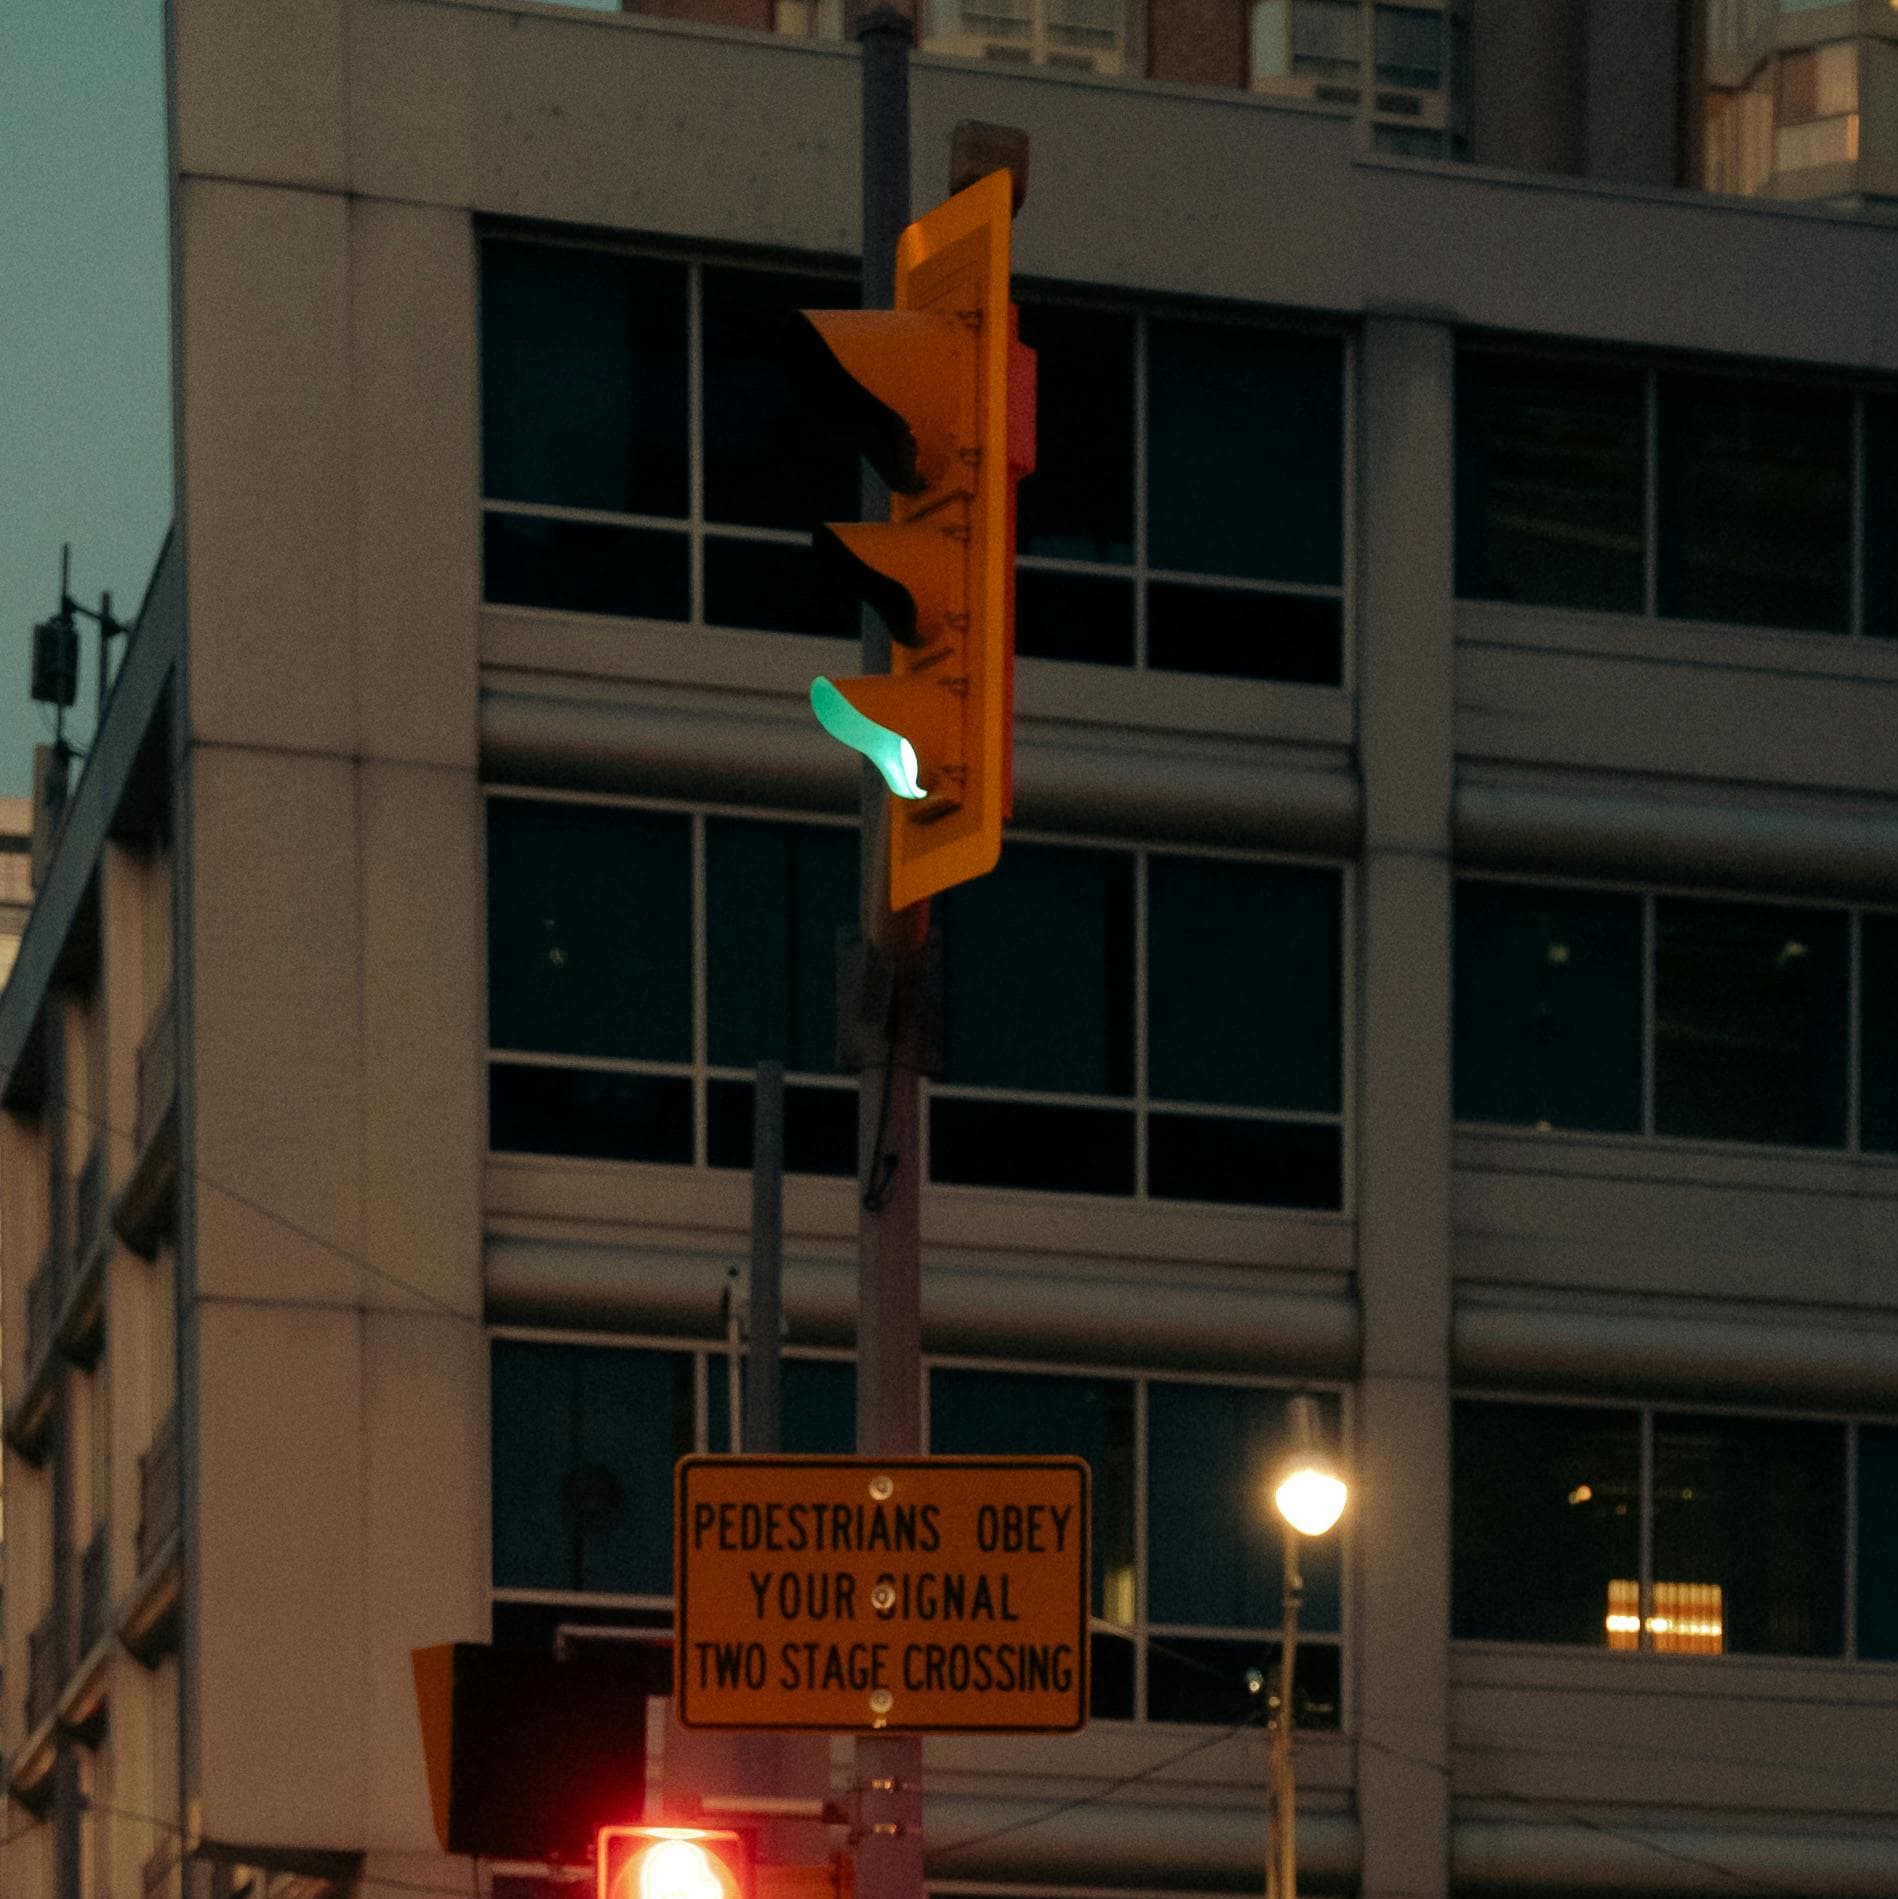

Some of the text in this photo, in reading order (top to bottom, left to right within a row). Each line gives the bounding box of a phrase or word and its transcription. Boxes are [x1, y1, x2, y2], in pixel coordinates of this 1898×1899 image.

[693, 1502, 1073, 1554] PEDESTRIANS OBEY
[748, 1571, 857, 1621] YOUR
[694, 1641, 1073, 1692] TWO STAGE CROSSING
